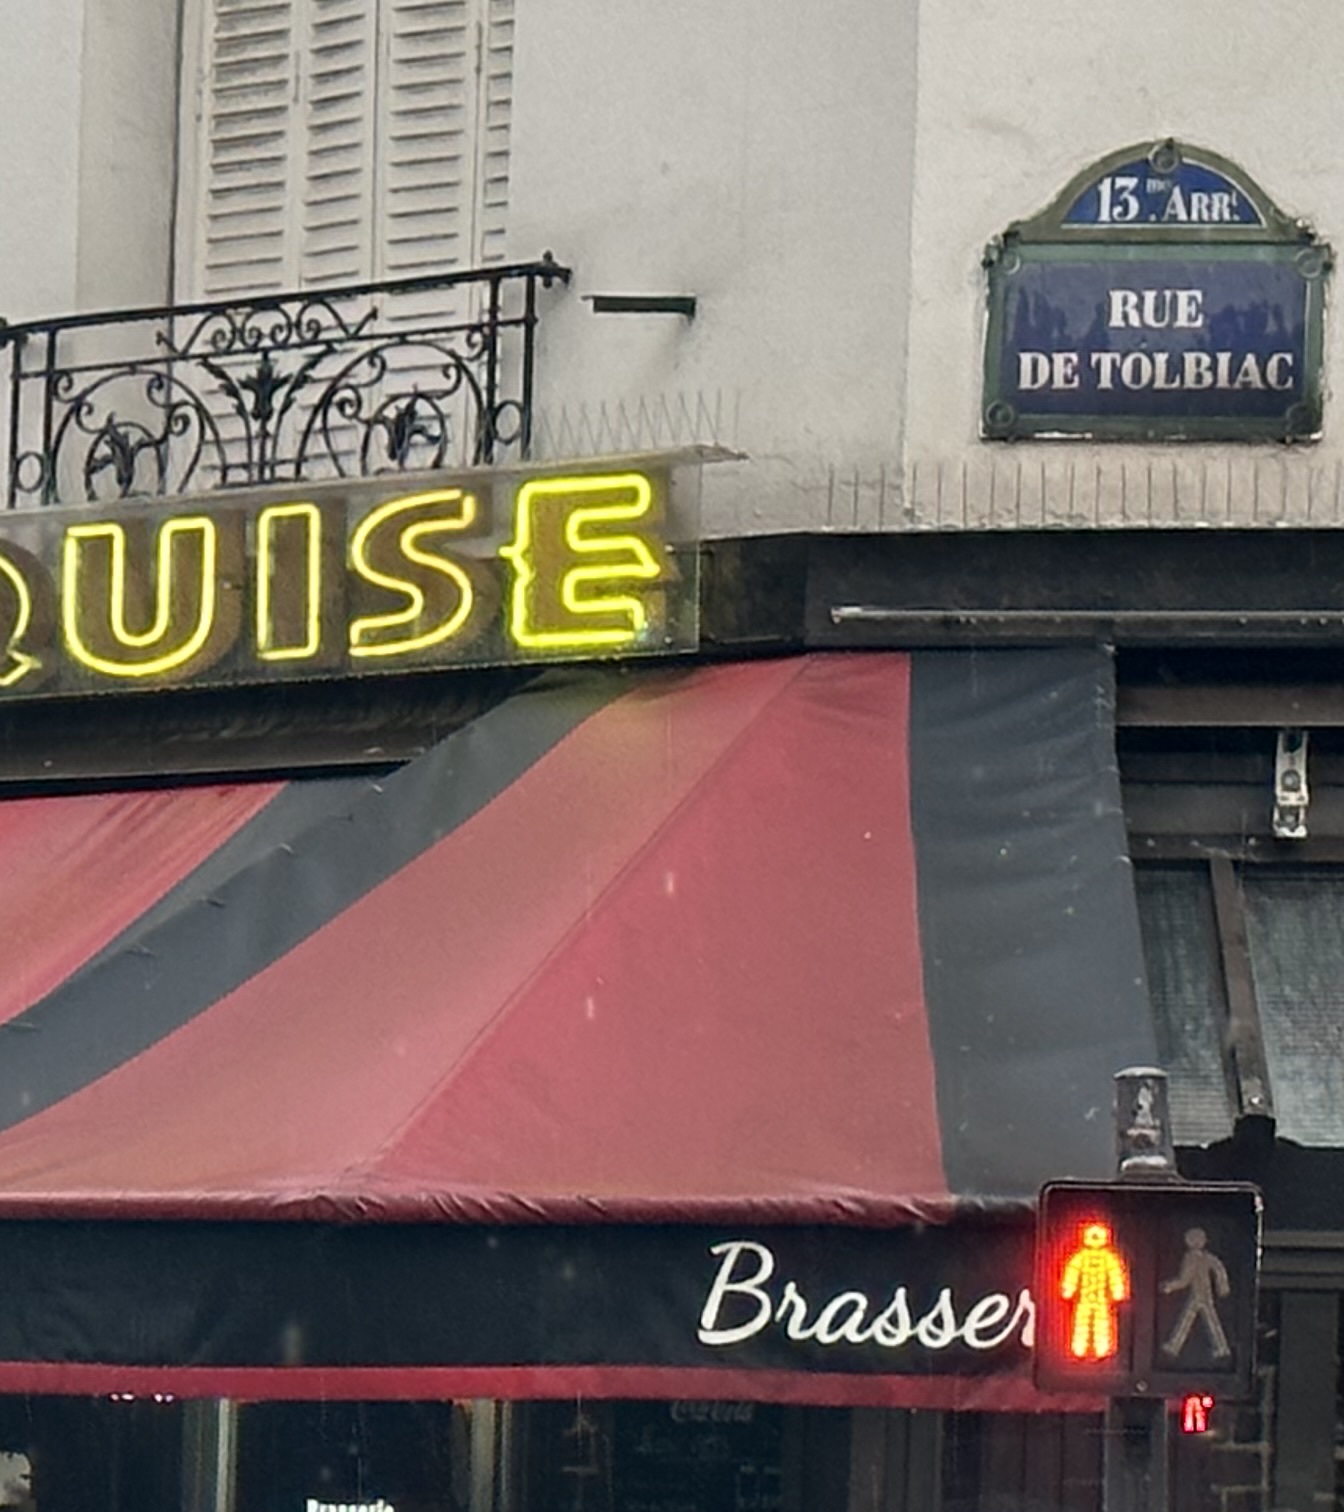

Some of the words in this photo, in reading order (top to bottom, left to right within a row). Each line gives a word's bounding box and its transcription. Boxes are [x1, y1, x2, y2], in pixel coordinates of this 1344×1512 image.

[1108, 289, 1204, 329] RUE
[1017, 352, 1080, 391] DE
[1090, 351, 1295, 391] TOLBIAC
